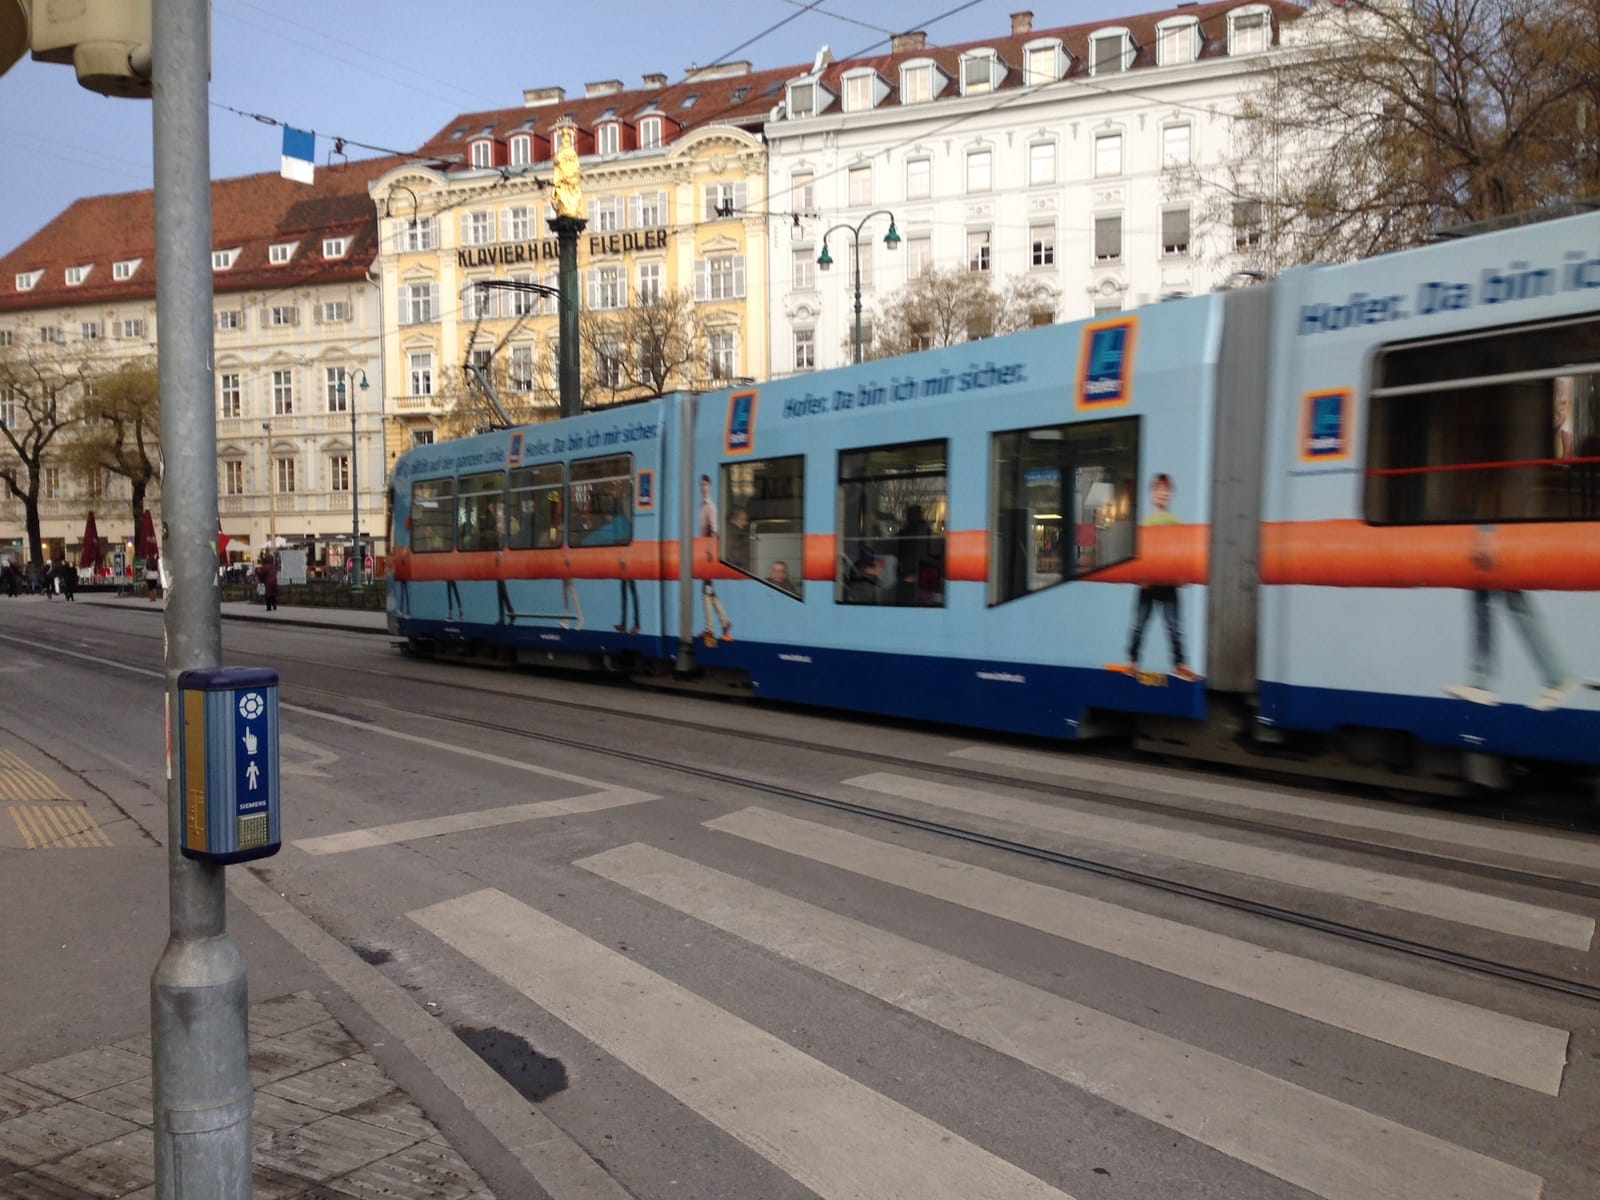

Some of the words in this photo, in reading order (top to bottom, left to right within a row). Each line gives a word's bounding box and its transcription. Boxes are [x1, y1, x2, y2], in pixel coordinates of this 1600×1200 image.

[458, 240, 560, 268] KLAVIERHAU
[590, 229, 667, 256] FIEDLER
[1414, 281, 1473, 316] Da
[1478, 260, 1556, 305] bin
[832, 389, 855, 411] Da
[857, 380, 887, 408] bin
[889, 375, 917, 401] ich
[920, 368, 956, 398] mir
[568, 431, 583, 451] bin
[586, 428, 601, 448] ich
[603, 425, 621, 445] mir
[240, 800, 266, 810] SIEMENS
